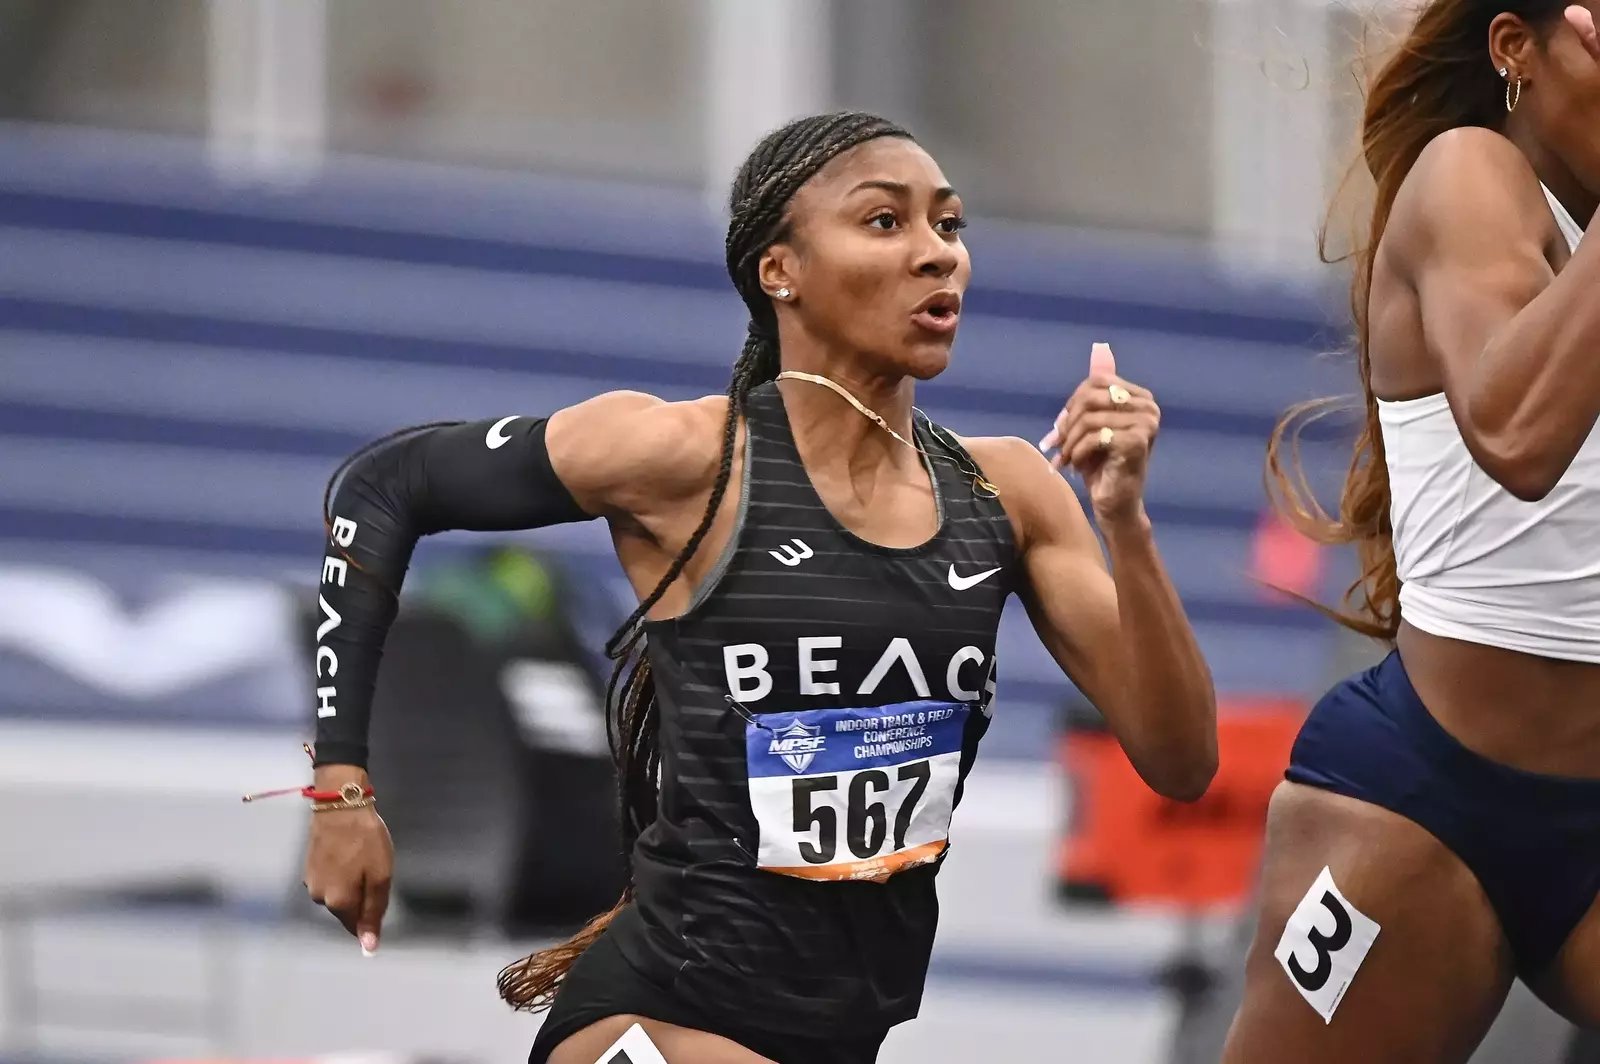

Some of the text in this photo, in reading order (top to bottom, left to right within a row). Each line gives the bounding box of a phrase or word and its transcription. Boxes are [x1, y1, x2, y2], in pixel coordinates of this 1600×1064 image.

[315, 515, 358, 719] BEACH
[835, 708, 954, 733] INDOOR TRACK & FIELD
[768, 736, 826, 752] MPSF
[863, 724, 927, 744] CONFERENCE
[853, 735, 933, 759] CHAMPIONSHIPS
[792, 760, 931, 864] 567
[1287, 889, 1353, 992] 3
